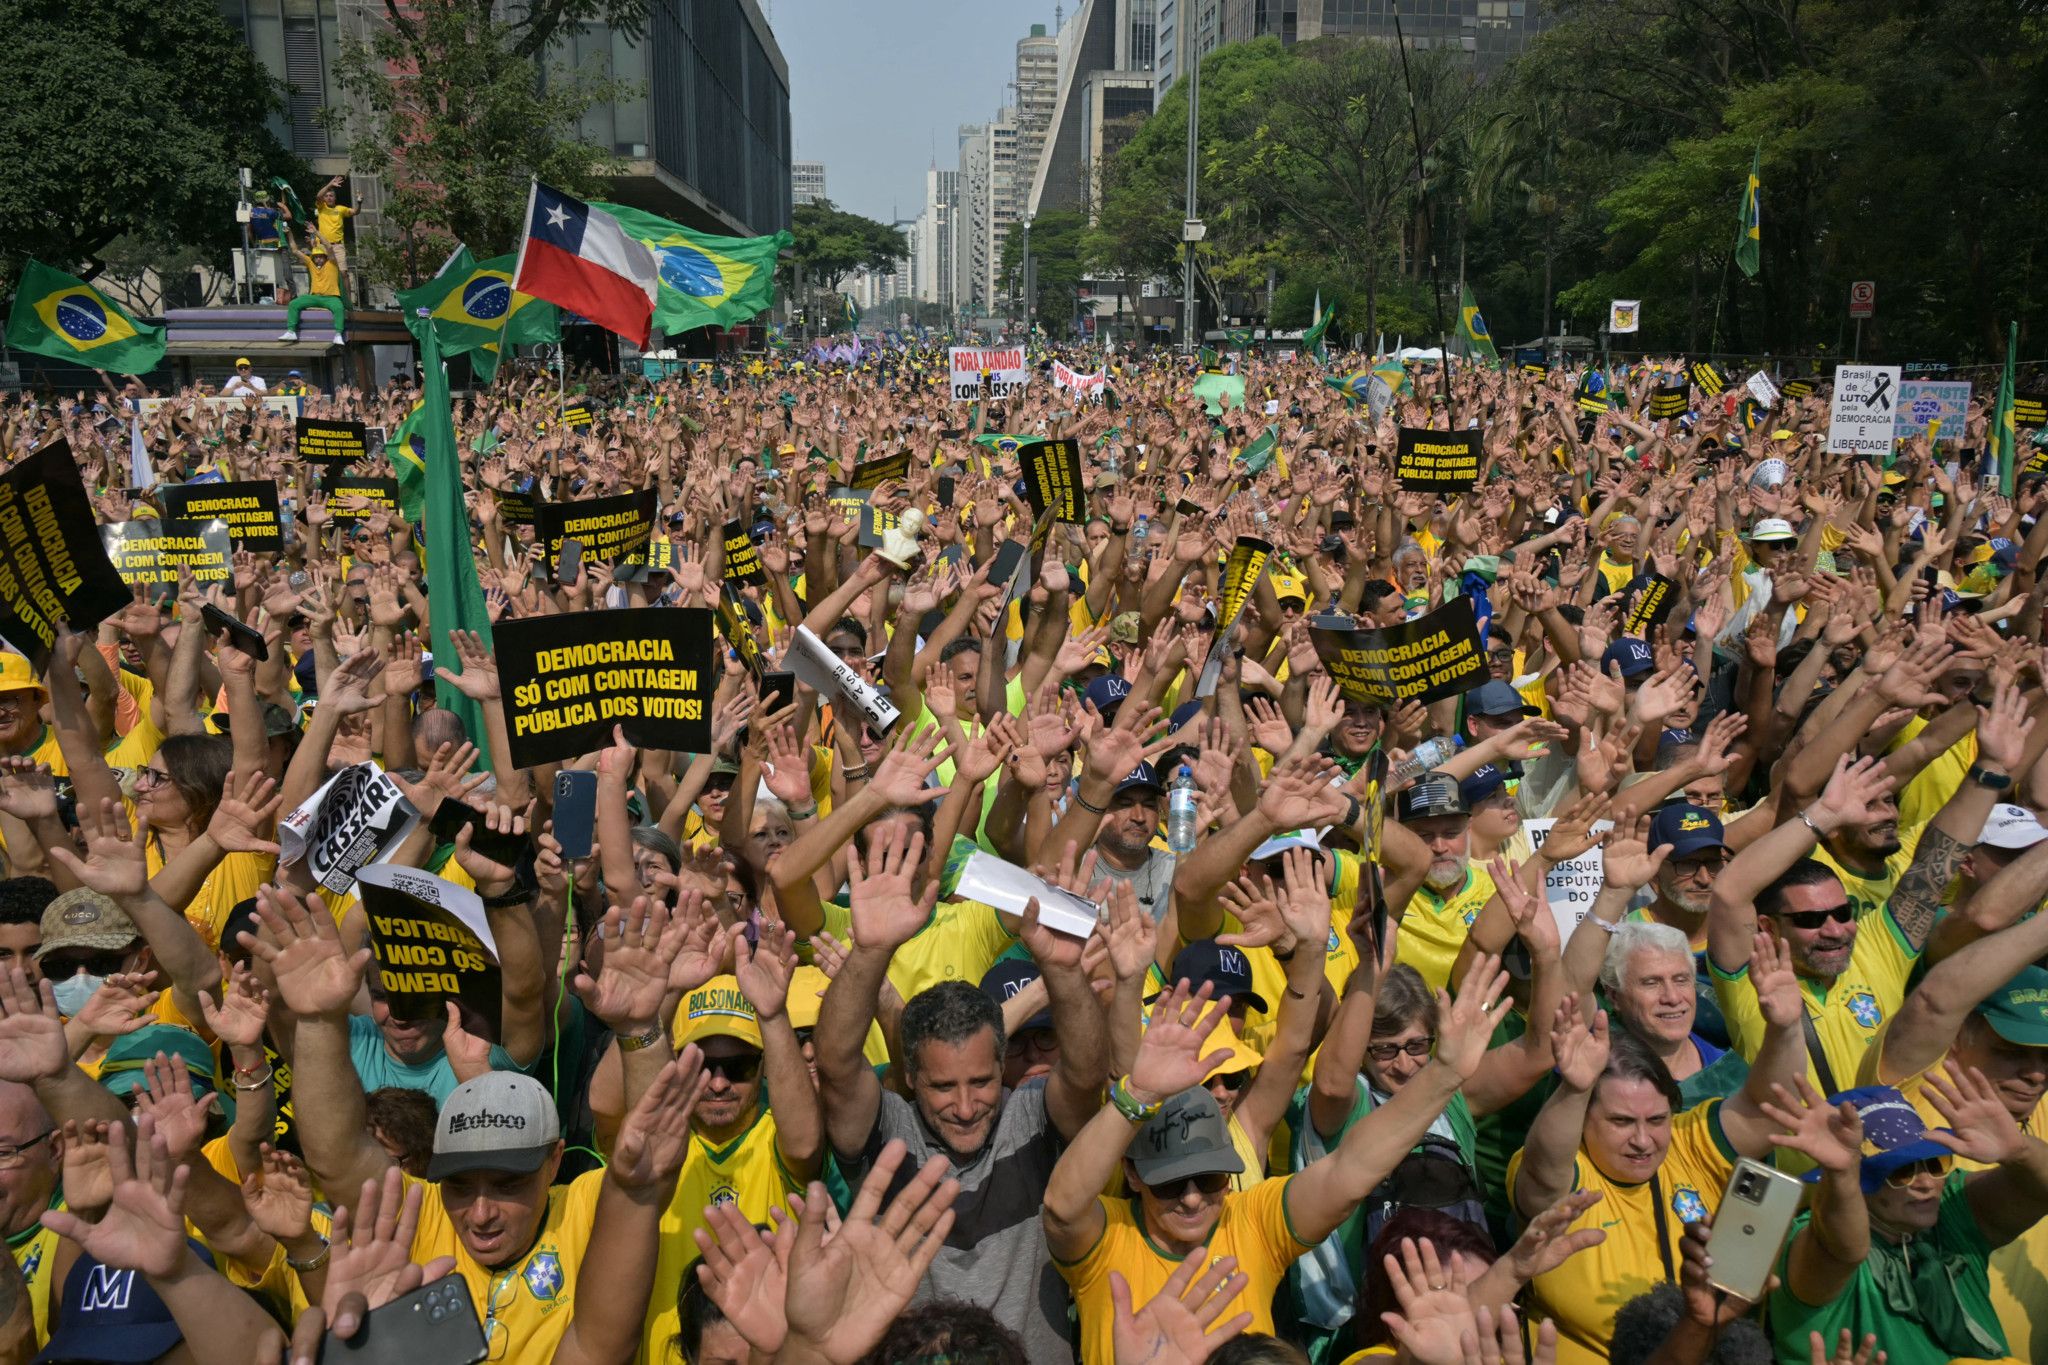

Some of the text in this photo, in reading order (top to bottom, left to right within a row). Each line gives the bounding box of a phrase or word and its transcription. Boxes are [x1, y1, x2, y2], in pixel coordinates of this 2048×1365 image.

[955, 350, 1021, 371] FORA XANDAO
[1905, 363, 1949, 372] BEATS
[1054, 365, 1074, 386] FORA
[1842, 370, 1871, 380] Brasil
[1845, 382, 1858, 392] de
[1900, 383, 1917, 398] ÃO
[1840, 394, 1868, 403] LUTO
[1841, 403, 1858, 412] pela
[1835, 414, 1891, 424] DEMOCRACIA
[308, 428, 353, 439] DEMOCRACIA
[1858, 426, 1866, 436] E
[300, 436, 362, 448] SÓ COM CONTAGEM
[1414, 443, 1468, 455] DEMOCRACIA
[1832, 439, 1889, 450] LIBERDADE
[299, 446, 325, 455] PÚBLICA
[327, 448, 341, 456] DOS
[1044, 445, 1061, 487] CONTAGEM
[1401, 454, 1477, 467] SÓ COM CONTAGEM
[1033, 456, 1053, 507] DEMOCRACIA
[1398, 466, 1477, 480] PÚBLICA DOS VOTOS!
[1055, 443, 1075, 521] PÚBLICA DOS VOTOS!
[334, 488, 385, 498] DEMOCRACIA
[187, 496, 260, 513] DEMOCRACIA
[0, 504, 29, 548] COM
[564, 509, 640, 533] DEMOCRACIA
[23, 483, 84, 597] DEMOCRACIA
[230, 525, 278, 538] OS VOTOS!
[597, 521, 650, 547] CONTAGEM
[121, 536, 207, 552] DEMOCRACIA
[125, 554, 155, 570] COM
[157, 551, 224, 568] CONTAGEM
[600, 547, 620, 561] DOS
[161, 571, 181, 583] DO
[738, 564, 755, 578] DOS
[1642, 582, 1669, 619] VOTOS!
[1340, 629, 1451, 664] DEMOCRACIA
[1631, 643, 1652, 660] M
[536, 639, 674, 673] DEMOCRACIA
[1330, 638, 1473, 682] SÓ COM CONTAGEM
[1335, 653, 1482, 699] PÚBLICA DOS VOTOS!
[514, 668, 697, 708] SÓ COM CONTAGEM
[1107, 679, 1128, 697] M
[515, 696, 703, 737] PÚBLICA DOS VOTOS!
[314, 774, 398, 873] CASSAR!
[1680, 818, 1711, 830] Brasil
[393, 872, 434, 886] DEPUTADOS
[1569, 891, 1589, 902] DO
[374, 915, 483, 950] PÚBLICA
[385, 944, 486, 973] SÓ COM
[1219, 949, 1245, 976] M
[536, 1268, 551, 1281] CBF
[81, 1264, 136, 1311] M
[540, 1294, 570, 1316] BRASIL
